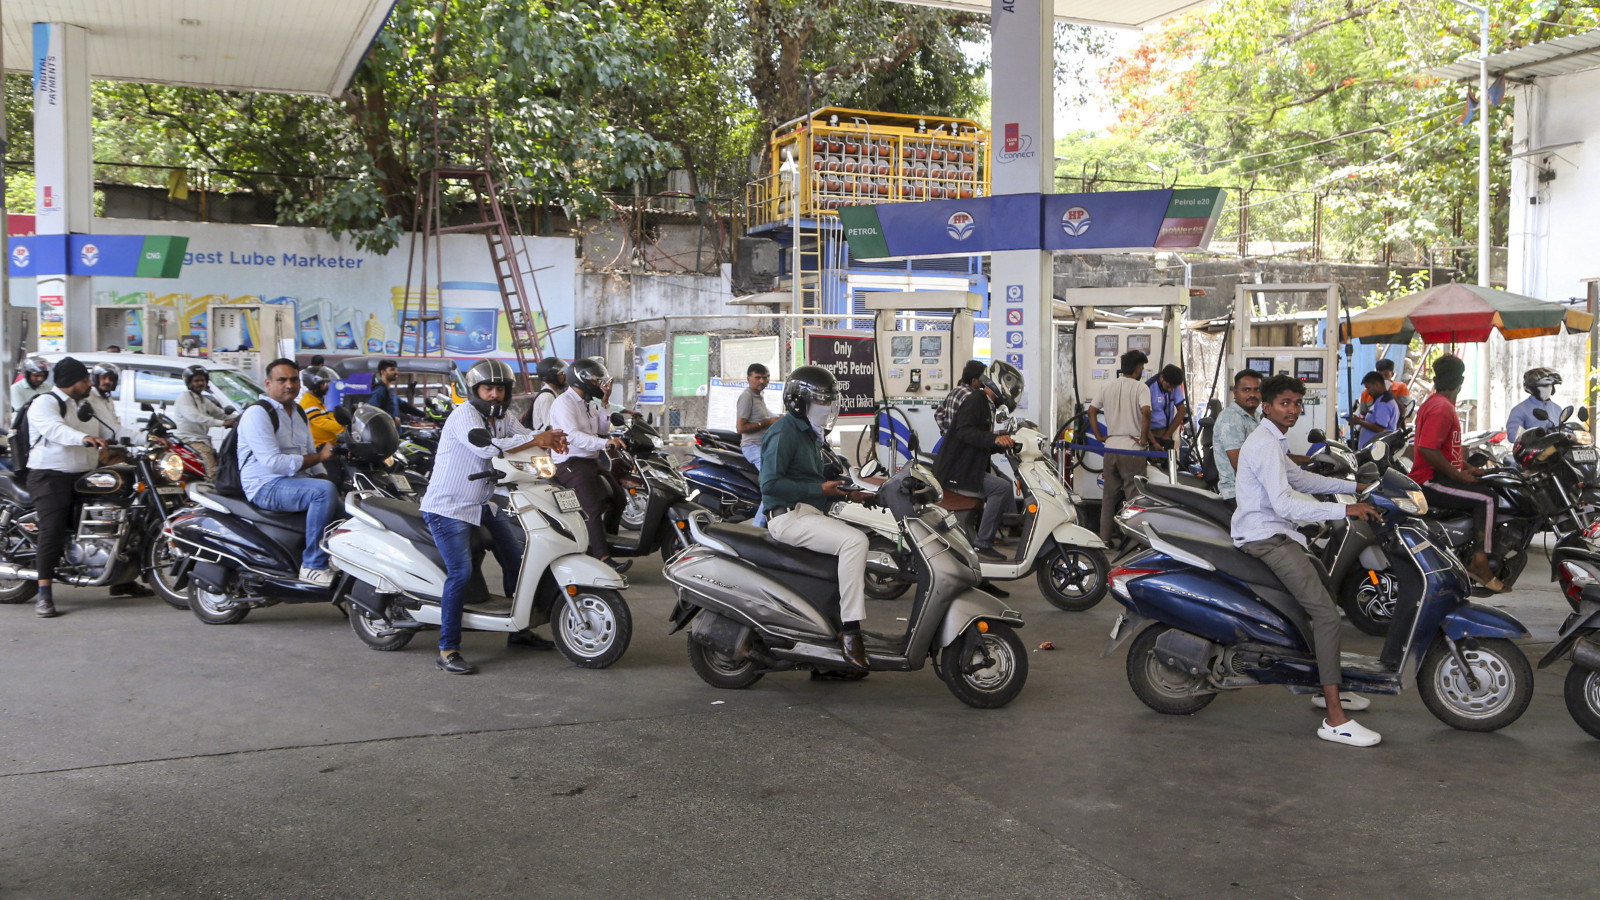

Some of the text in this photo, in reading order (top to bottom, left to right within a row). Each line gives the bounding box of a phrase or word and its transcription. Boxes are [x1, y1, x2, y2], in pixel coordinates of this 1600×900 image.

[48, 56, 56, 105] PAYMENTS
[953, 215, 969, 224] HP
[1068, 210, 1084, 220] HP
[847, 227, 878, 236] PETROL
[146, 252, 161, 260] CNG
[230, 251, 276, 266] Lube
[283, 253, 364, 269] Marketer
[834, 341, 852, 358] Only
[850, 361, 874, 375] Petrol
